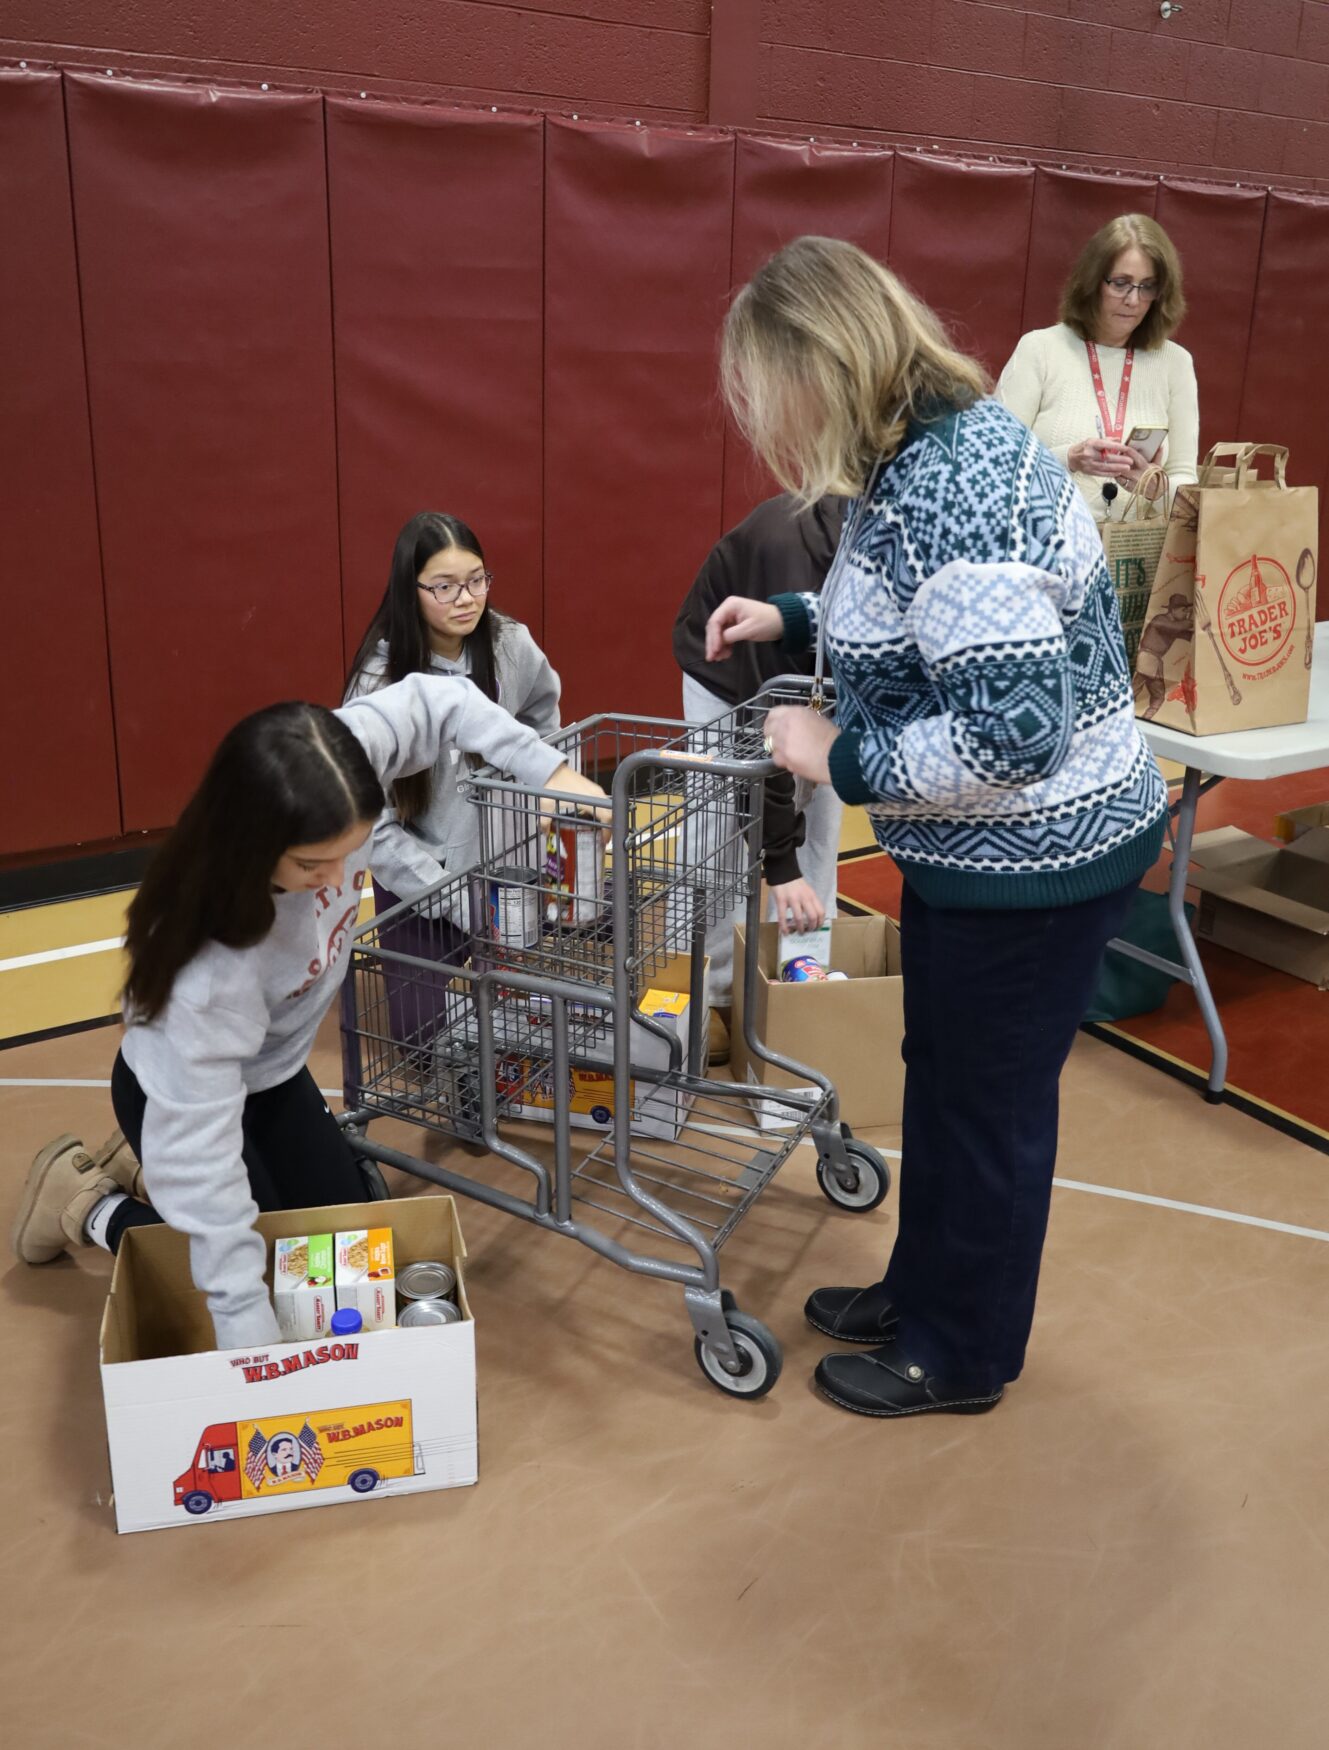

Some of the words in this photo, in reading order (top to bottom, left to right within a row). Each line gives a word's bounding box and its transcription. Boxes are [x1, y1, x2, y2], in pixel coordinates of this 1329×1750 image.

[1228, 601, 1288, 639] TRADER
[1238, 623, 1282, 654] JOE'S
[230, 1357, 251, 1368] WHO
[253, 1354, 270, 1363] BUT
[242, 1343, 360, 1384] W.B.MASON
[326, 1416, 403, 1443] W.B.MASON
